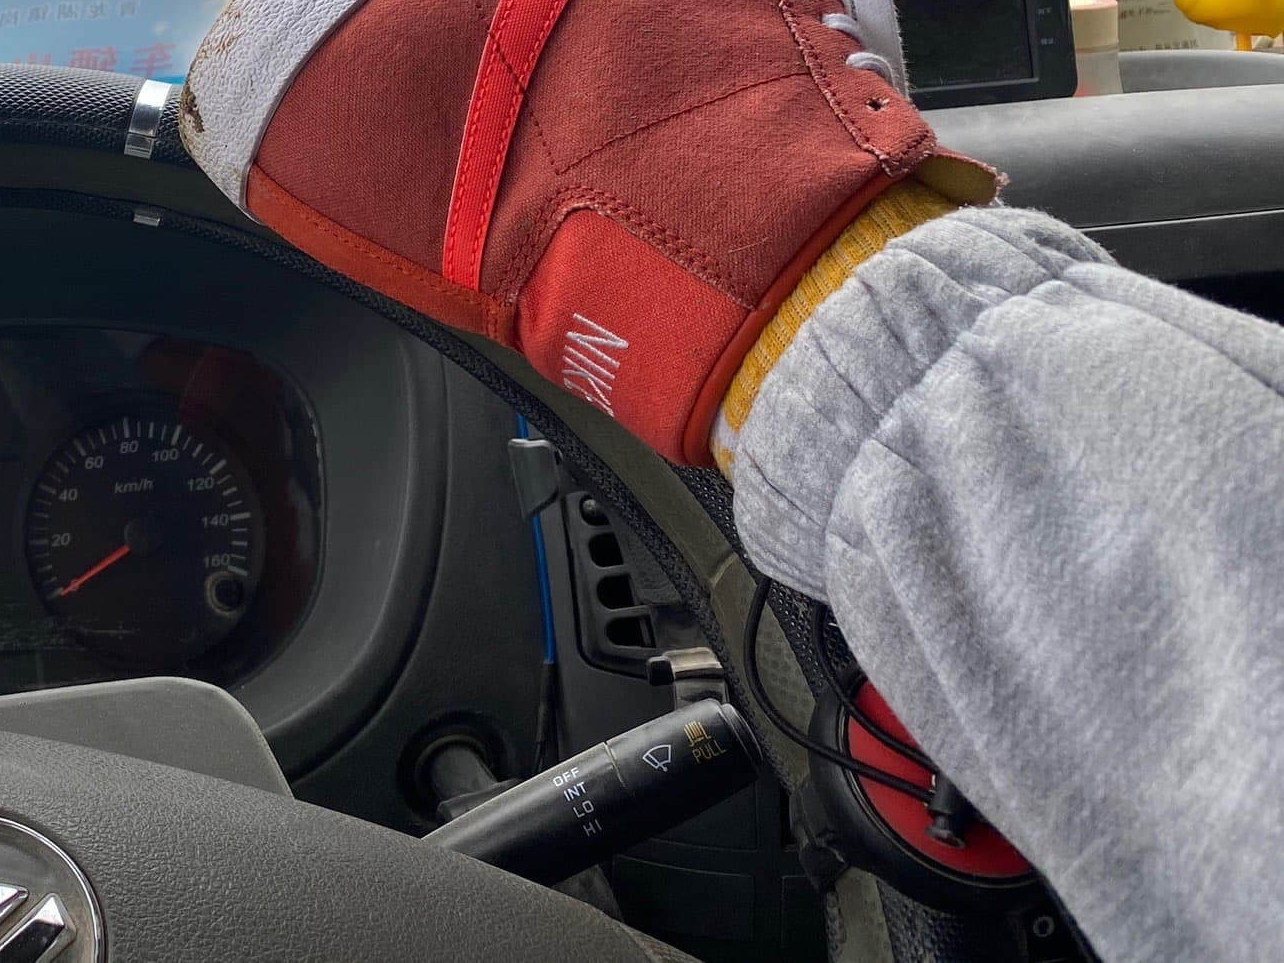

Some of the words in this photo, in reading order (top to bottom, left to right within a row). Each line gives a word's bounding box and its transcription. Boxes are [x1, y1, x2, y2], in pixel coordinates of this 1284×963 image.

[119, 440, 139, 454] 80
[84, 455, 104, 469] 60
[152, 448, 179, 462] 100
[115, 478, 153, 494] km/h
[188, 476, 214, 491] 120
[58, 488, 78, 502] 40
[202, 514, 228, 527] 140
[51, 533, 70, 547] 20
[203, 553, 230, 568] 160
[692, 742, 726, 764] PULL
[552, 767, 579, 787] OFF
[563, 781, 586, 801] INT
[573, 800, 594, 818] LO
[583, 819, 602, 836] HI
